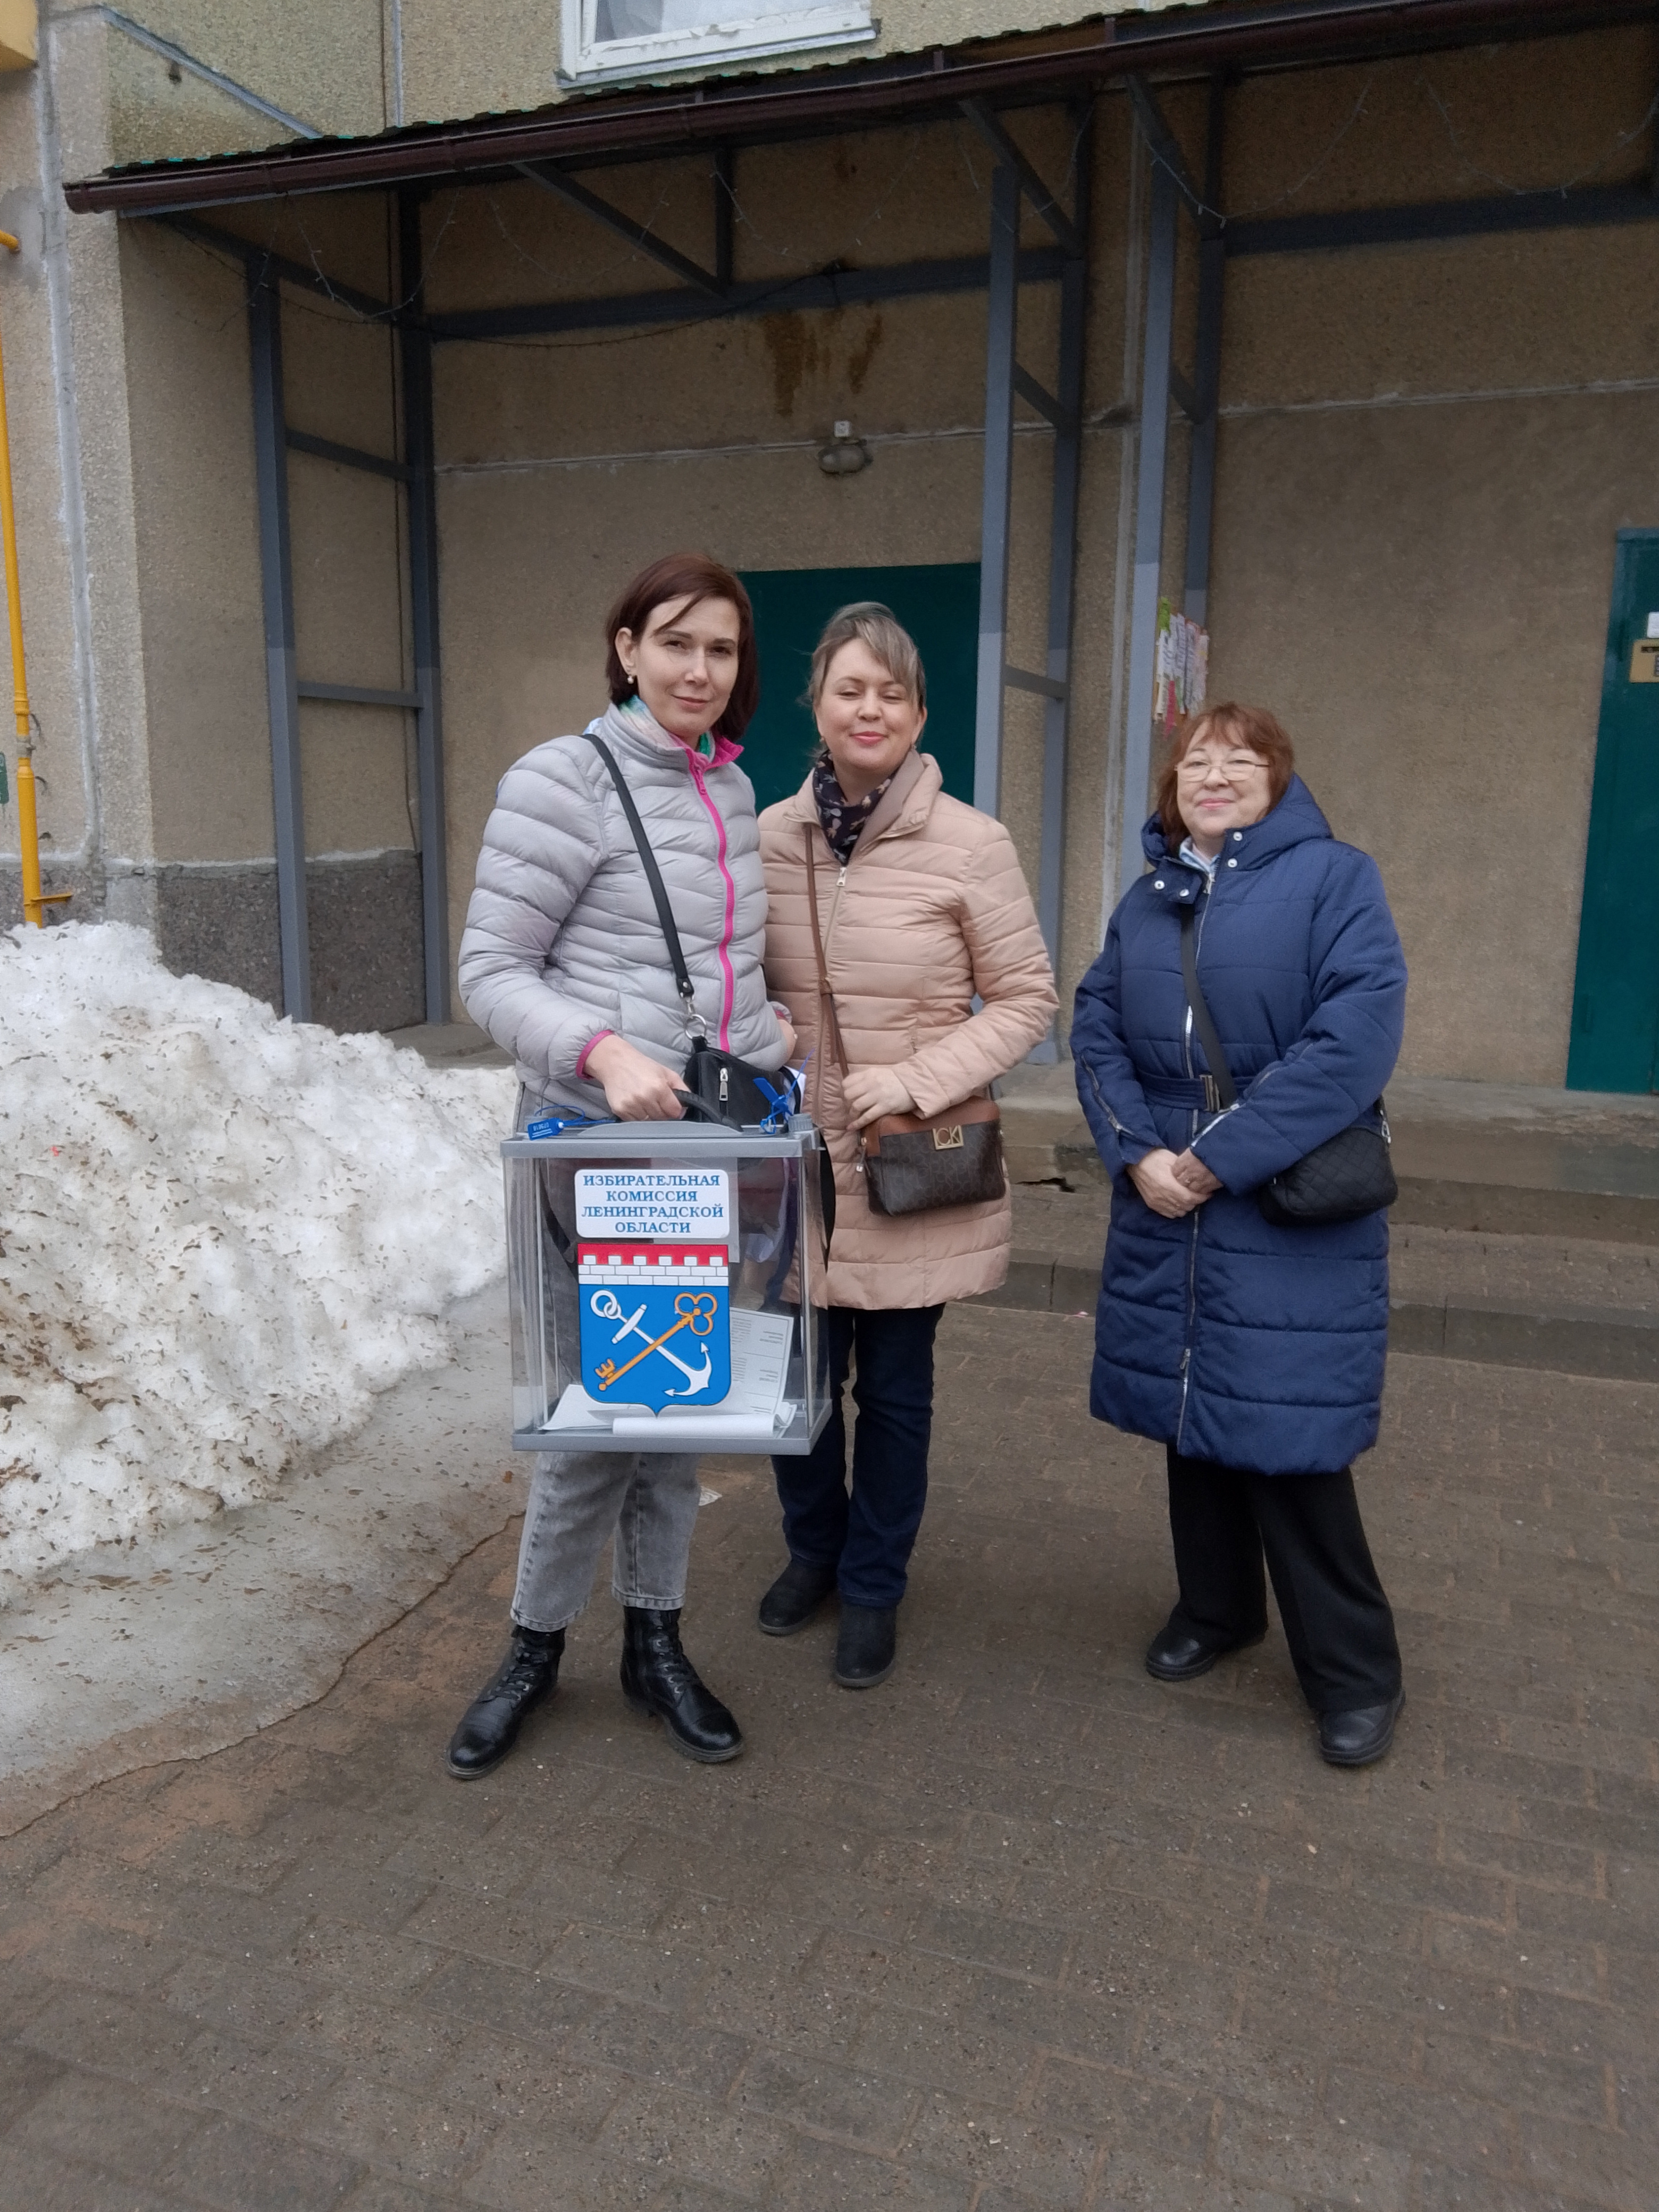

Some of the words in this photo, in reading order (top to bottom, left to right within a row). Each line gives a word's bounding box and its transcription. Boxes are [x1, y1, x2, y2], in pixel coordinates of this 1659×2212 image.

[936, 1126, 960, 1146] CK
[583, 1175, 720, 1186] ИЗБИРАТЕЛЬНАЯ
[606, 1191, 698, 1202] КОМИССИЯ
[581, 1203, 724, 1219] ЛЕНИНГРАДСКОЙ
[615, 1222, 691, 1233] ОБЛАСТИ
